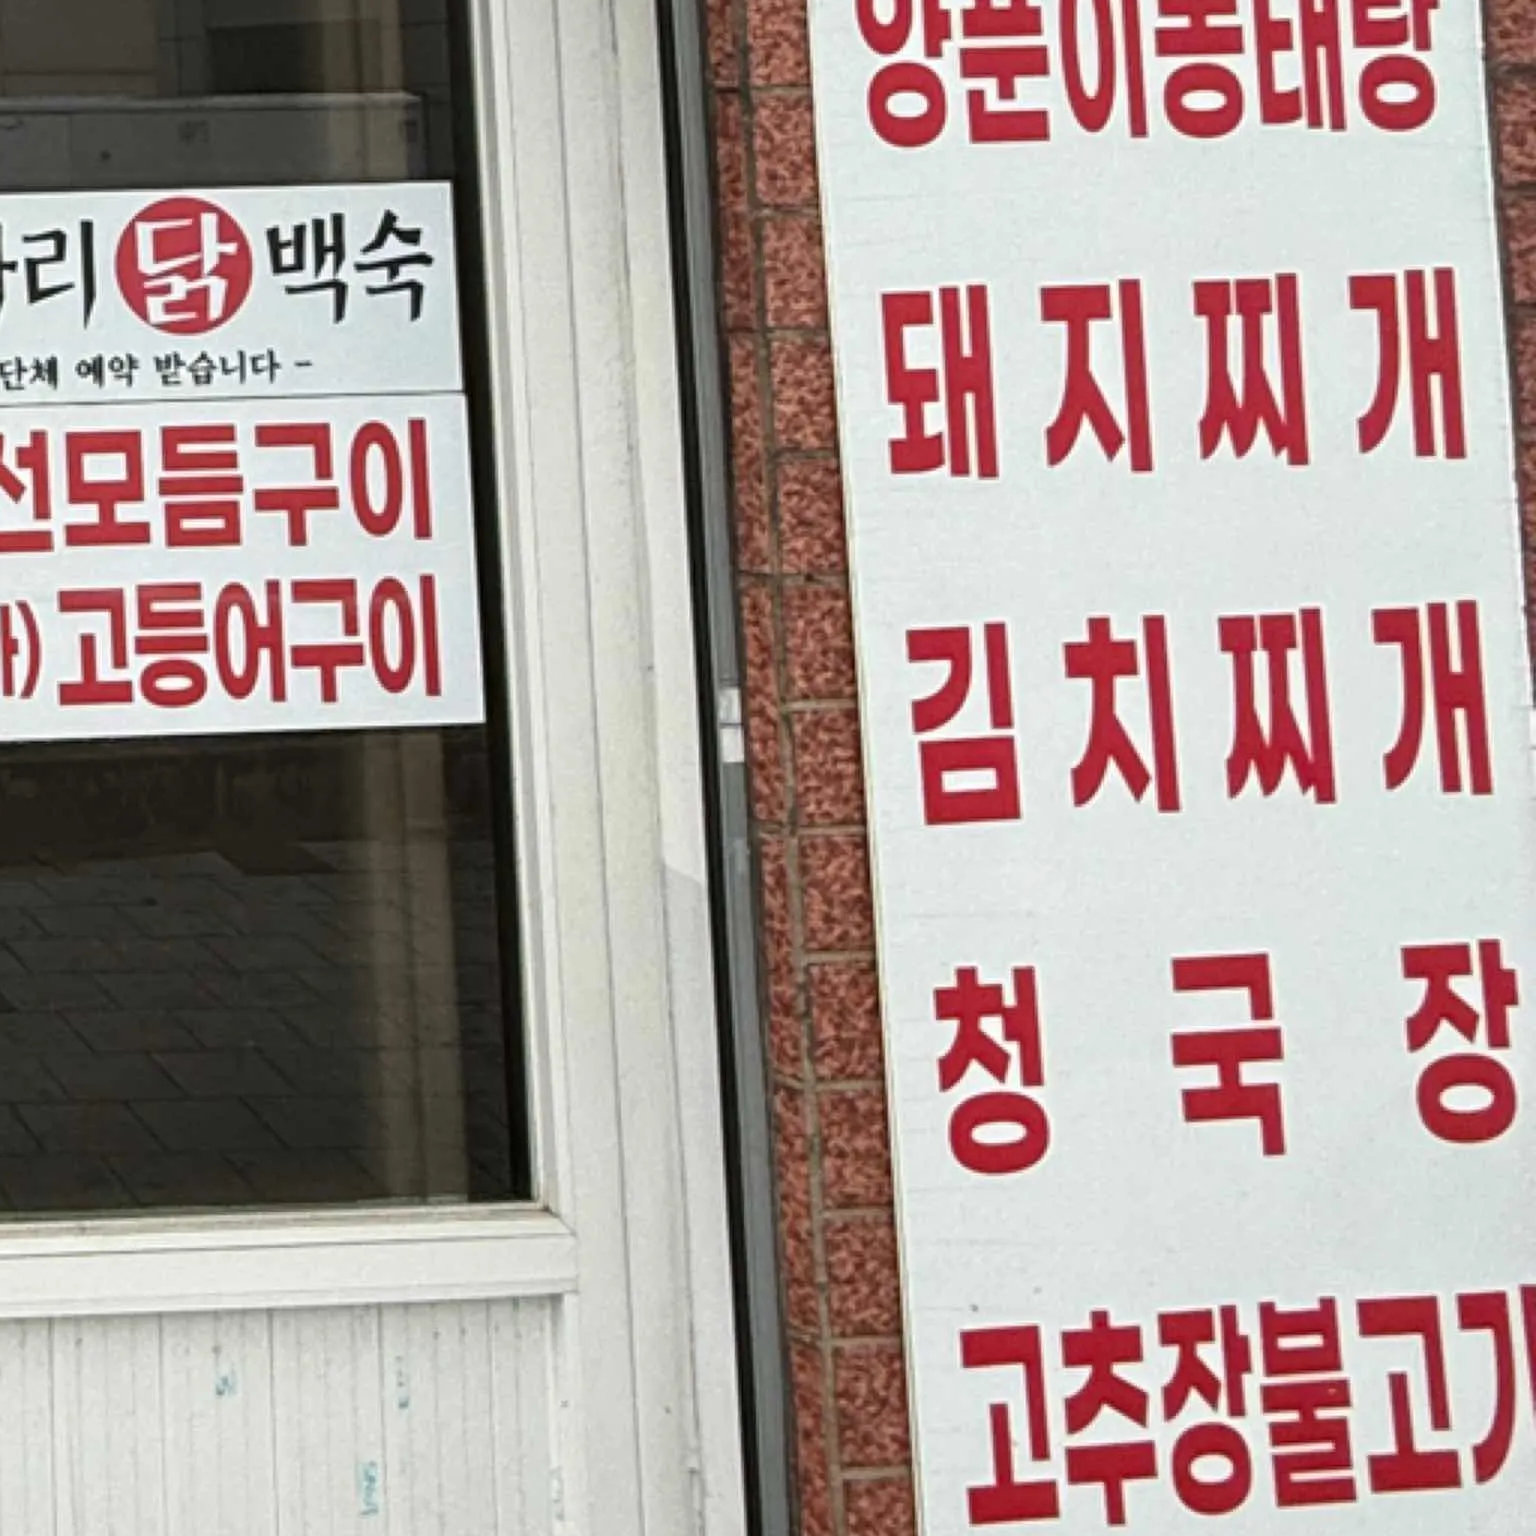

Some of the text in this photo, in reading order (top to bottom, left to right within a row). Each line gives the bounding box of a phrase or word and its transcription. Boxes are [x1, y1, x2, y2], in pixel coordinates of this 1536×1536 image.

[76, 355, 139, 386] 예약
[155, 351, 280, 384] 받습니다
[883, 269, 1466, 478] 돼지찌개
[907, 601, 1493, 824] 김치찌개
